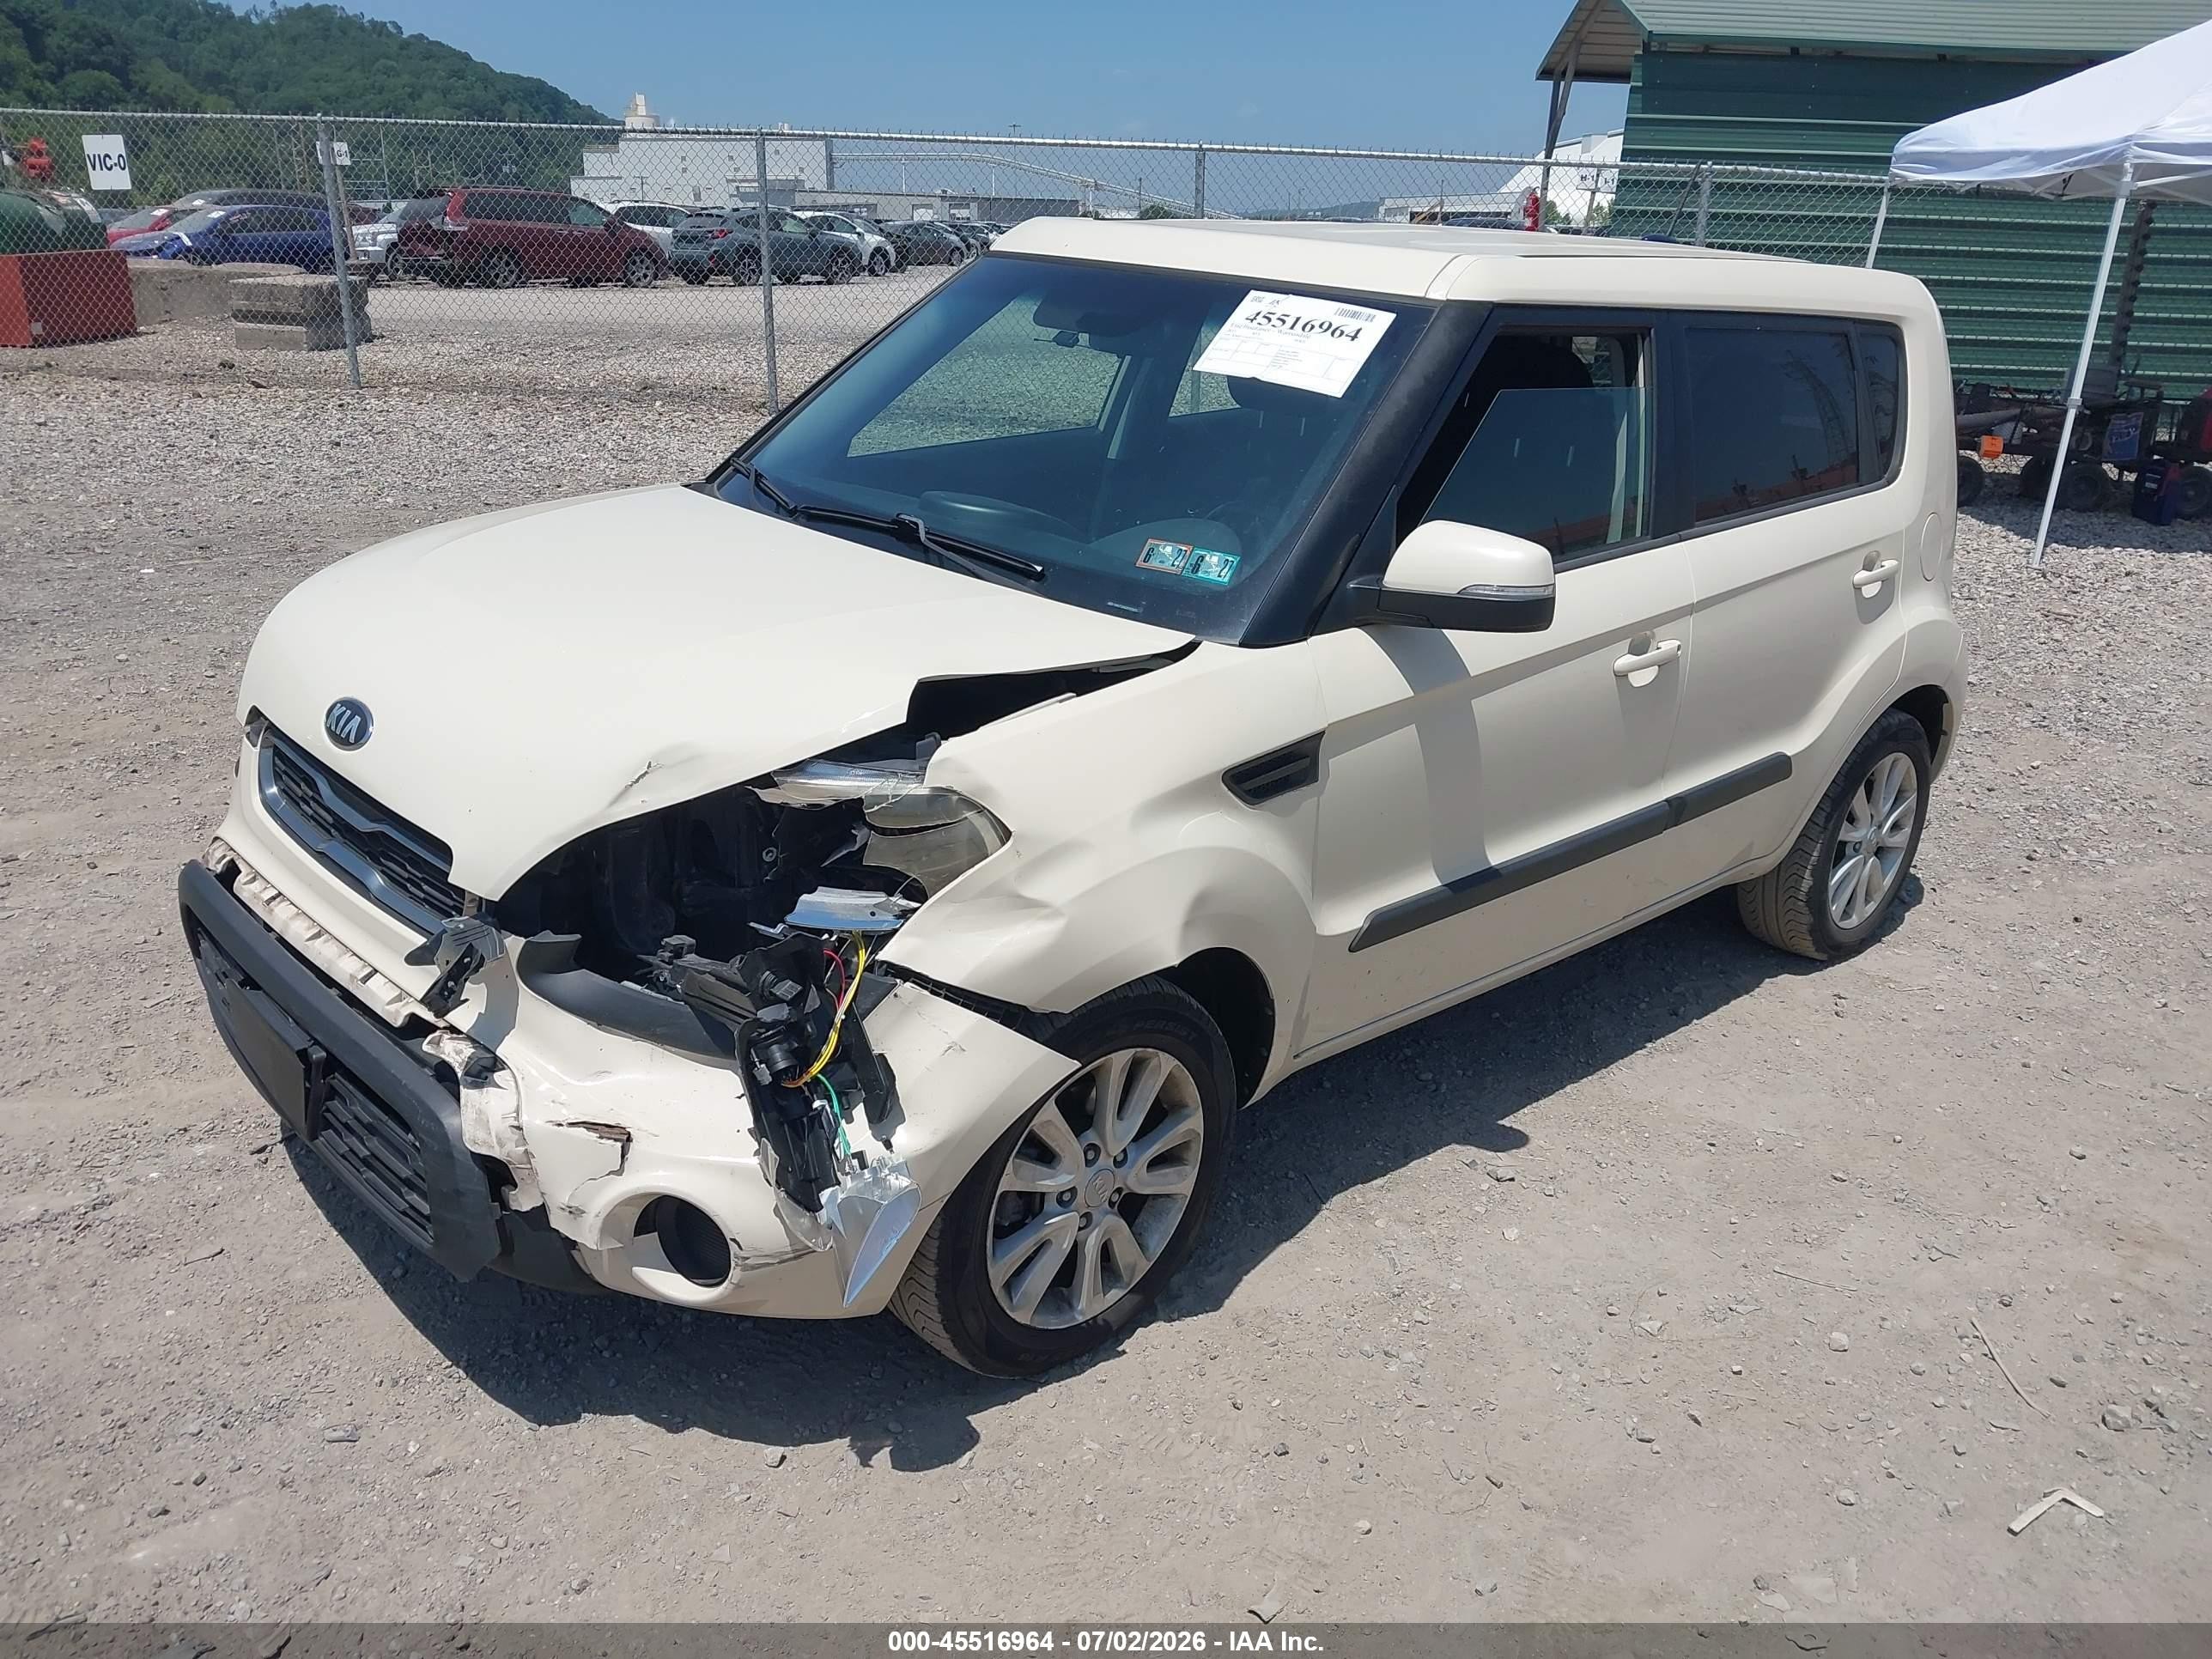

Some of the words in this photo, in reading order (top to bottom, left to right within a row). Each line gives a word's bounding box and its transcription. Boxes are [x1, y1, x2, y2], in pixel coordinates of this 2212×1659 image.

[1244, 310, 1363, 342] 45516964
[1142, 547, 1155, 564] 6
[1191, 555, 1205, 574] 6
[1217, 558, 1235, 580] 27
[326, 702, 362, 744] KIA
